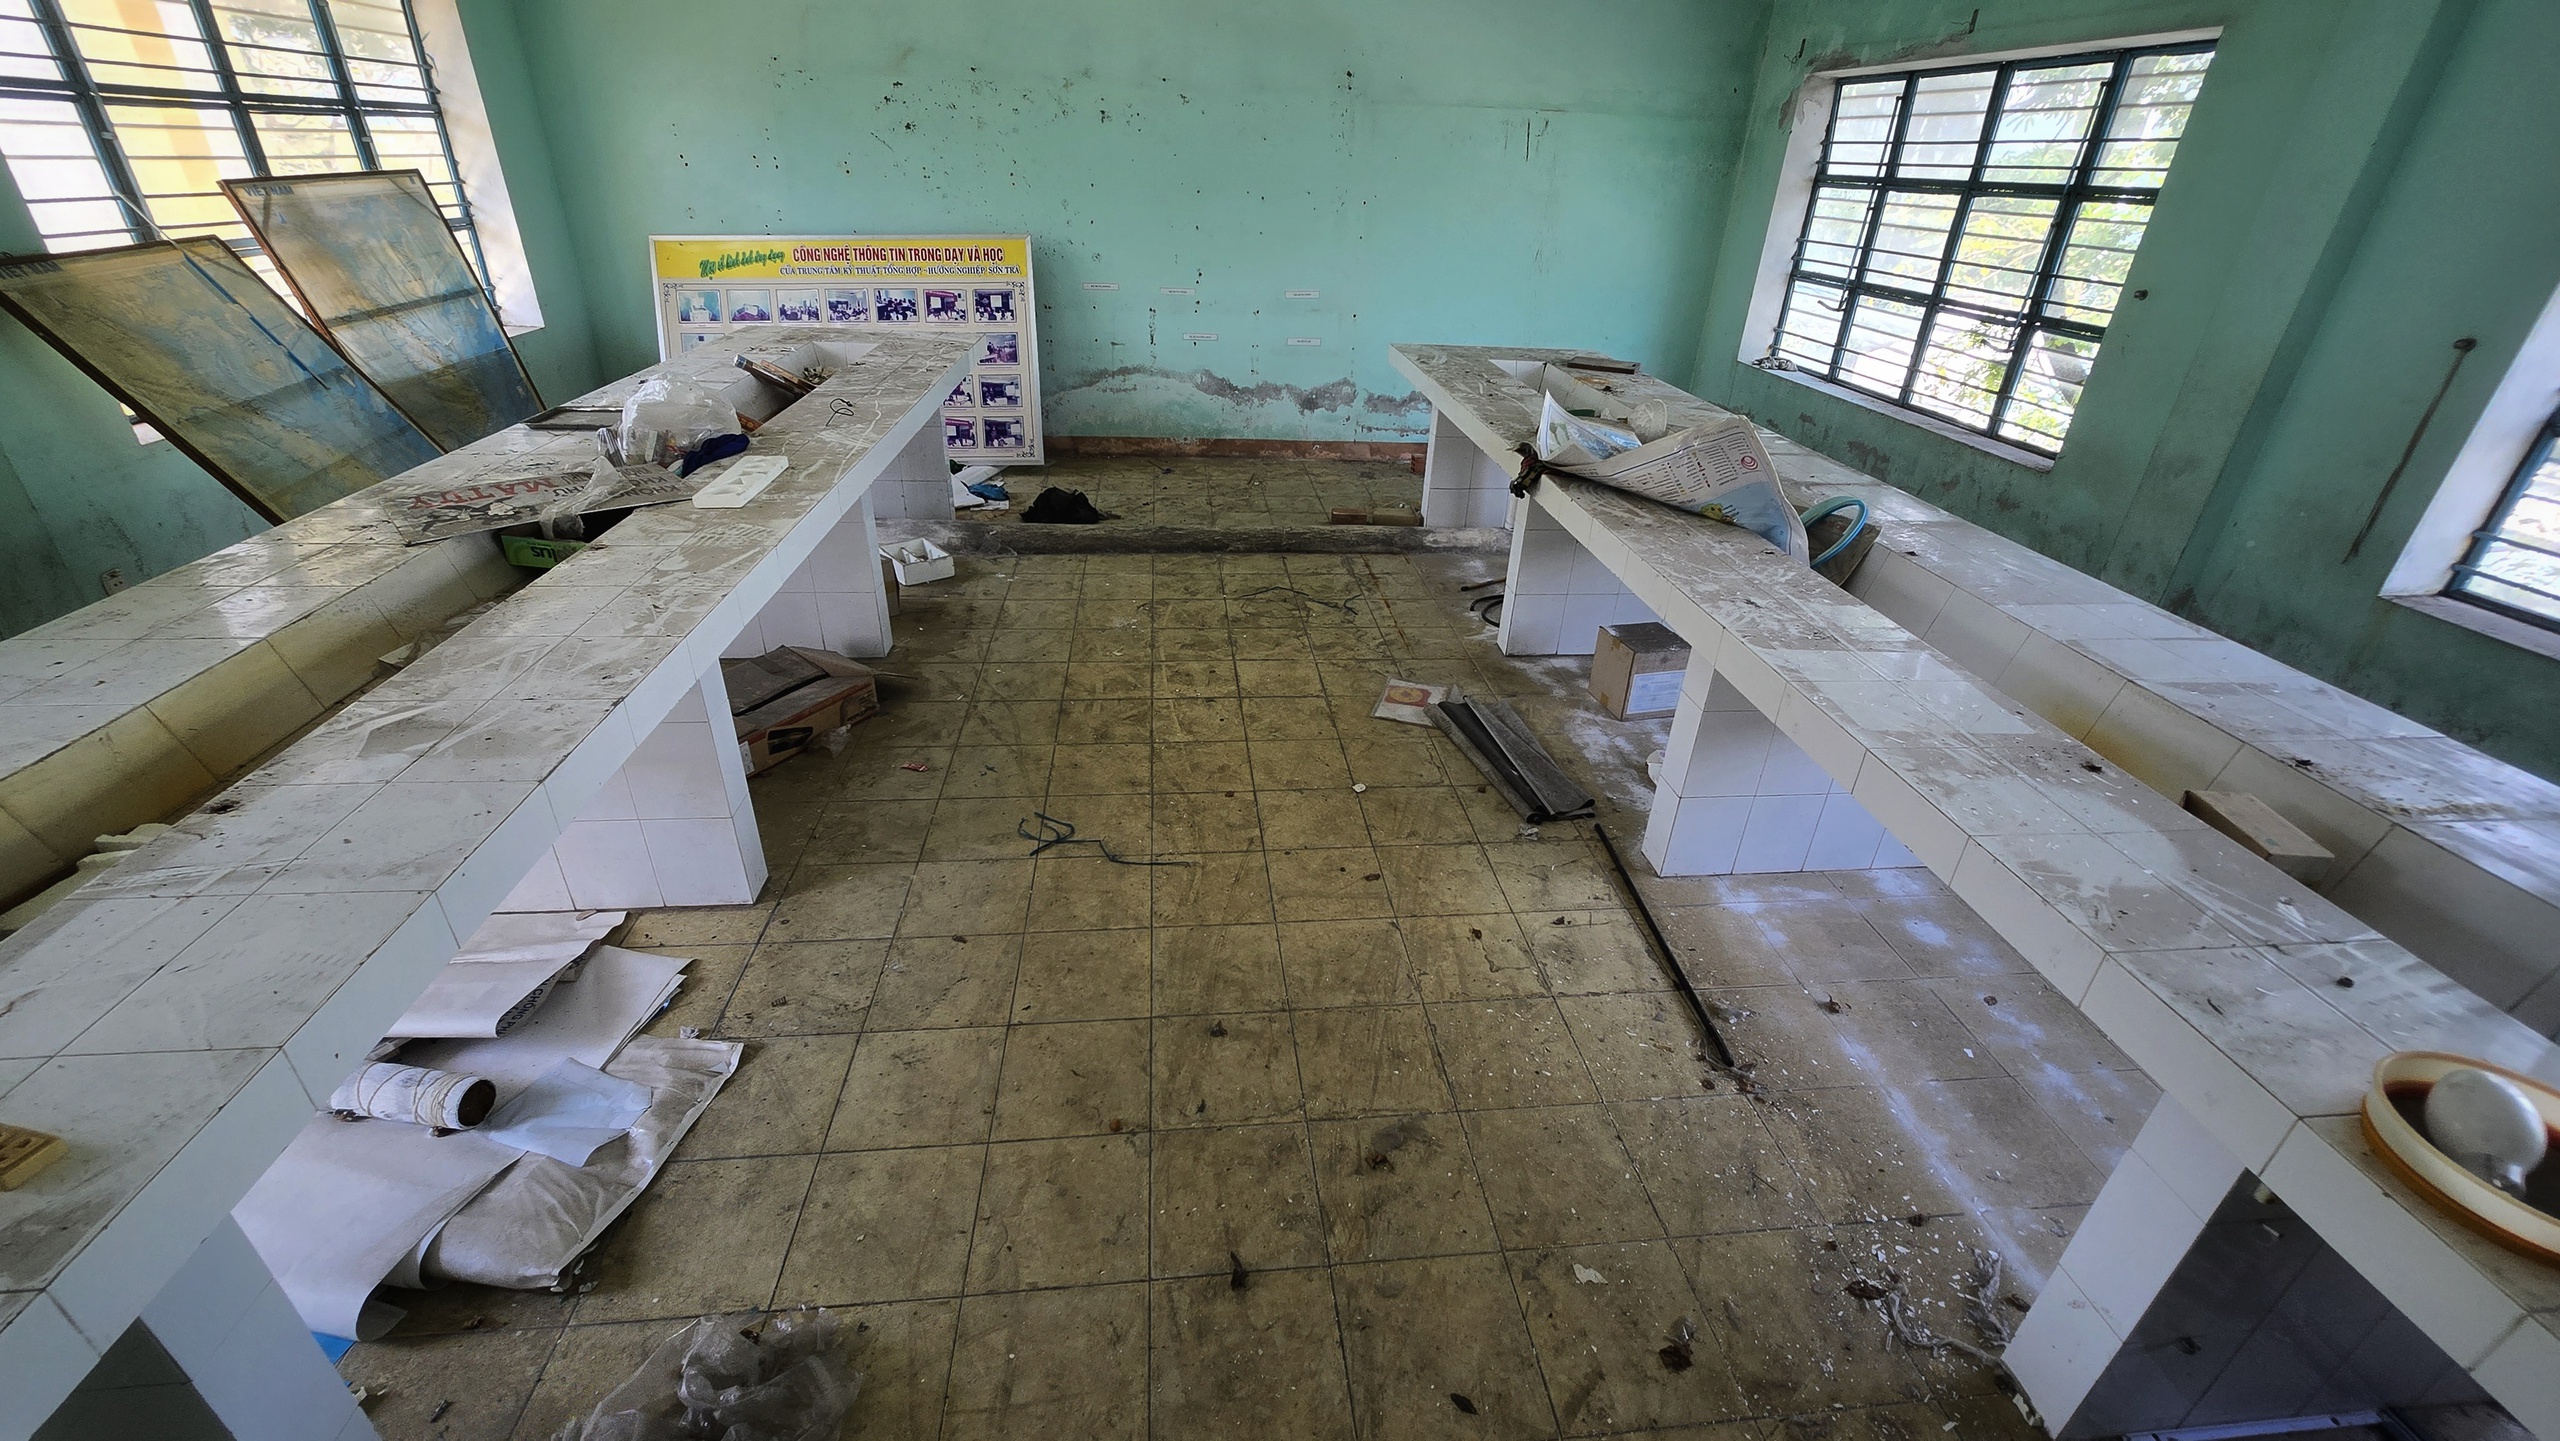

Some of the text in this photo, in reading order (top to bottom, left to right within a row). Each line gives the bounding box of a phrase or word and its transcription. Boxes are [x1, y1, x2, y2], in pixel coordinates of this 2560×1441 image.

[792, 243, 1004, 265] CÔNG NGHỆ THÔNG TIN TRONG DẠY VÀ HỌC
[779, 264, 796, 275] CỦA
[797, 266, 824, 275] TRUNG
[824, 265, 841, 275] TÂM
[855, 265, 881, 277] THUẬT
[905, 265, 923, 277] HỢP
[956, 264, 986, 277] NGHIỆP
[988, 265, 1004, 275] SƠN
[1005, 263, 1020, 275] TRÀ
[511, 988, 544, 1020] CHỐNG
